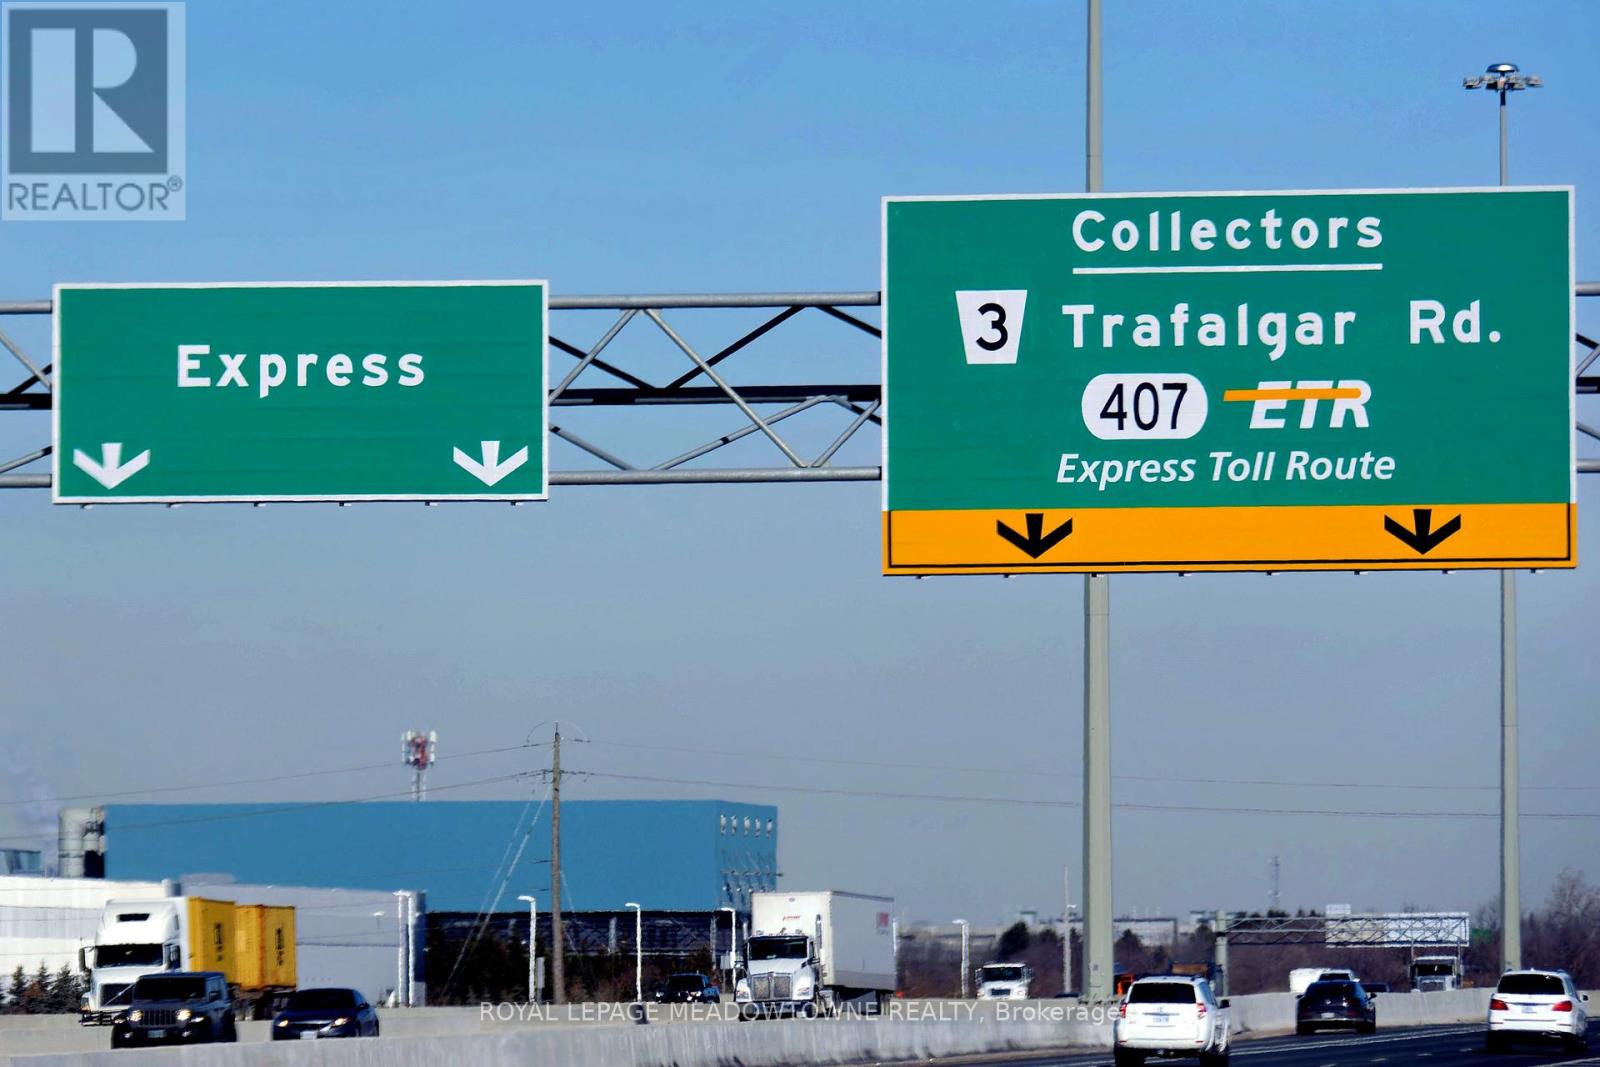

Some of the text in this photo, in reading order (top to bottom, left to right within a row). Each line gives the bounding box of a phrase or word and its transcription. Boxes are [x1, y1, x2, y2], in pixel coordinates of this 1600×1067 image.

[1072, 209, 1383, 252] Collectors
[975, 302, 1009, 352] 3
[1061, 299, 1502, 361] Trafalgar Rd.
[177, 344, 425, 399] Express
[1099, 379, 1372, 431] 407 ETR
[1056, 450, 1396, 491] Express Toll Route
